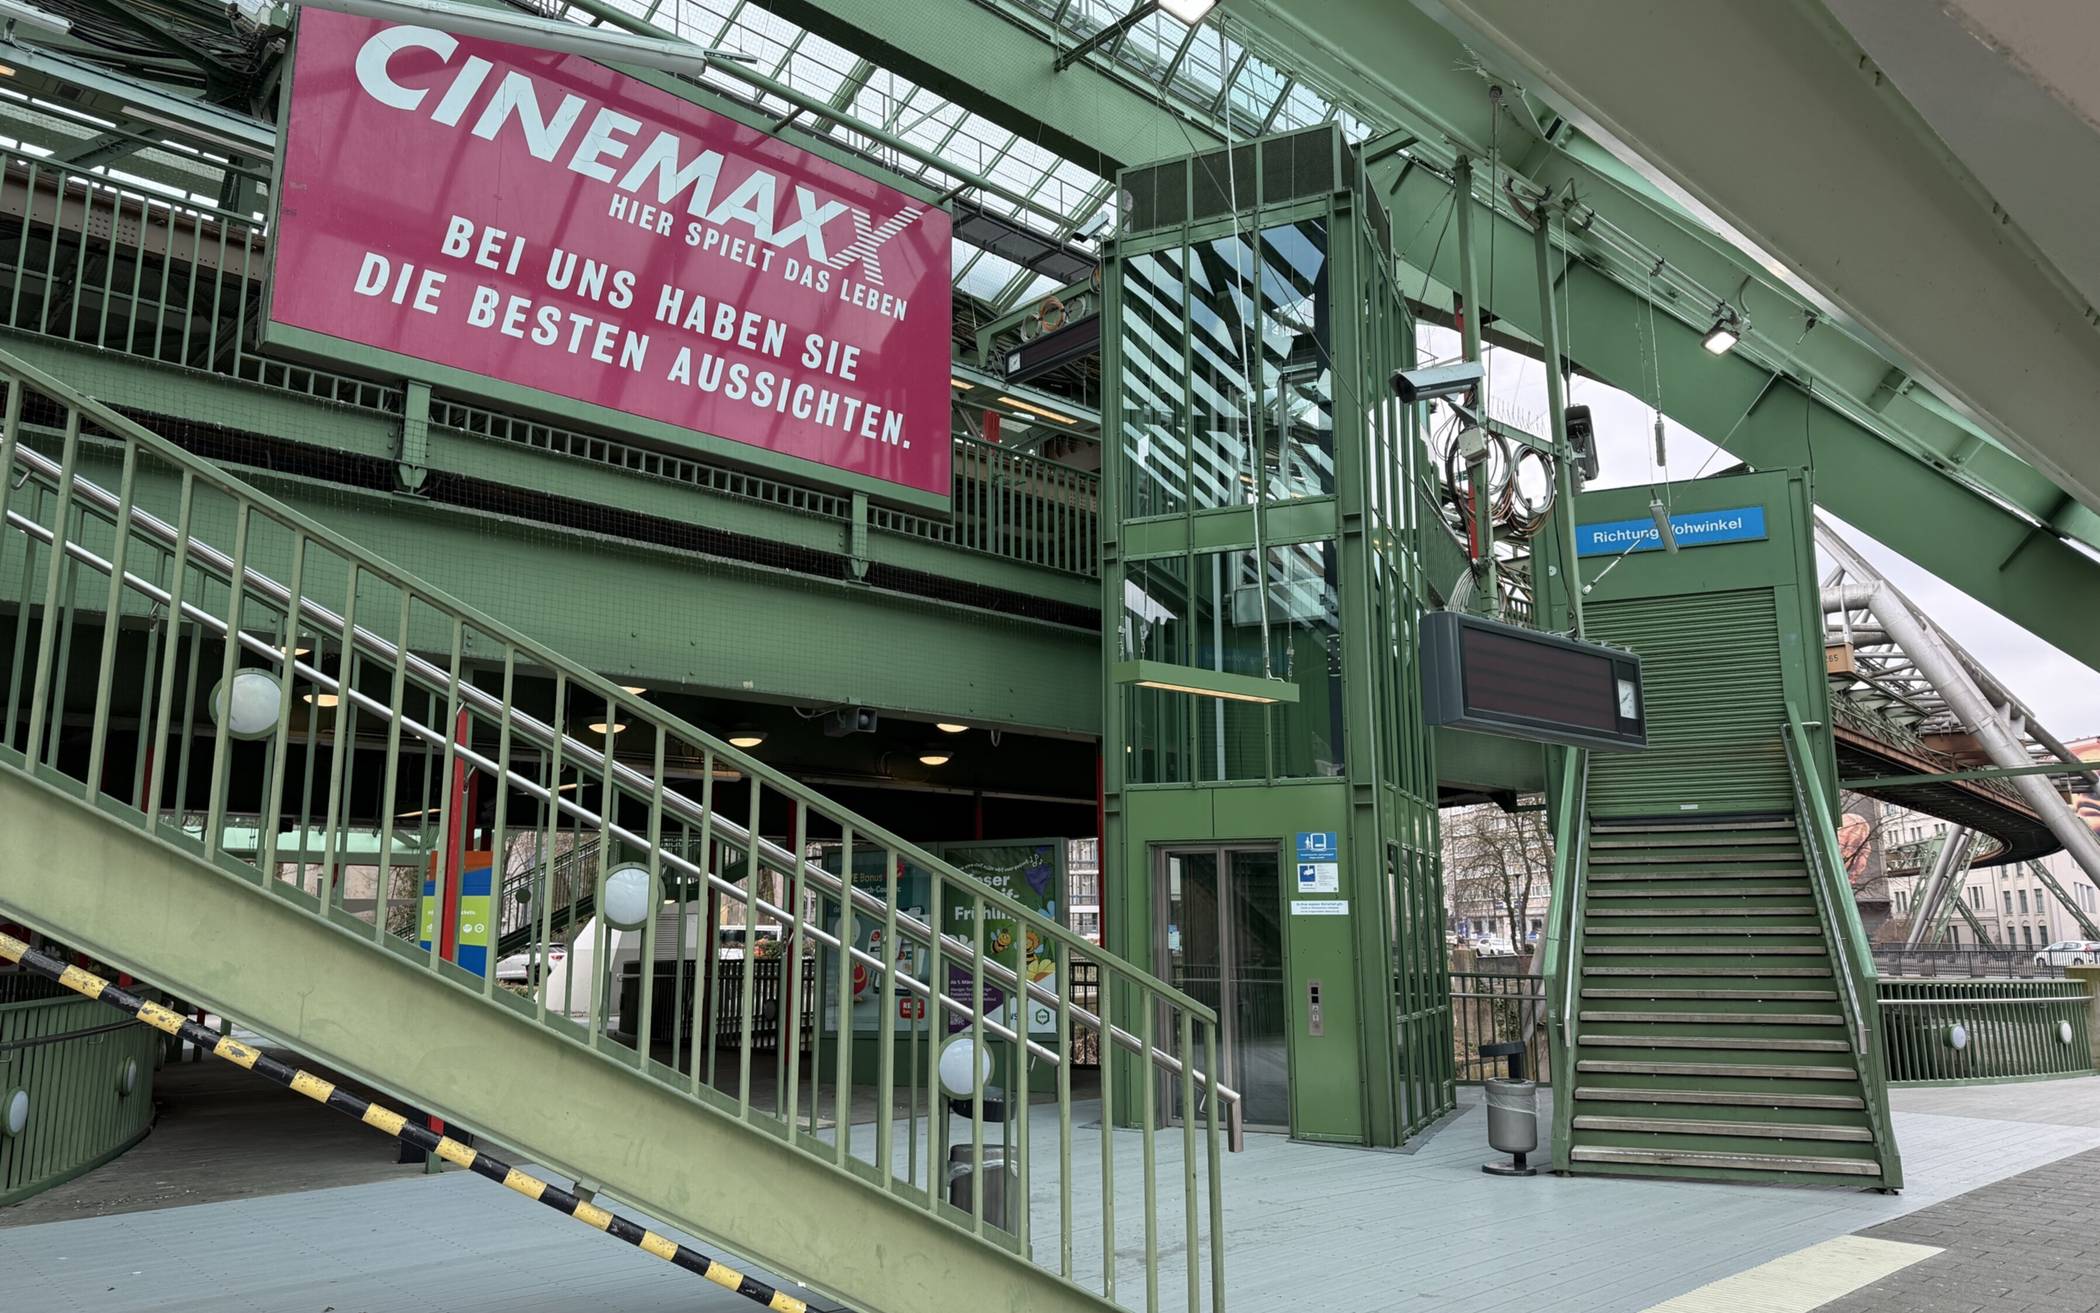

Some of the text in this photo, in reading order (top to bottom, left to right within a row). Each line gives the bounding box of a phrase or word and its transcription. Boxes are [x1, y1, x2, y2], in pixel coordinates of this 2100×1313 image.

[355, 25, 923, 286] CINEMAXX
[441, 215, 861, 382] BEI UNS HABEN SIE
[608, 193, 908, 321] HIER SPIELT DAS LEBEN
[354, 252, 911, 449] DIE BESTEN AUSSICHTEN.
[1593, 528, 1659, 543] Richtung
